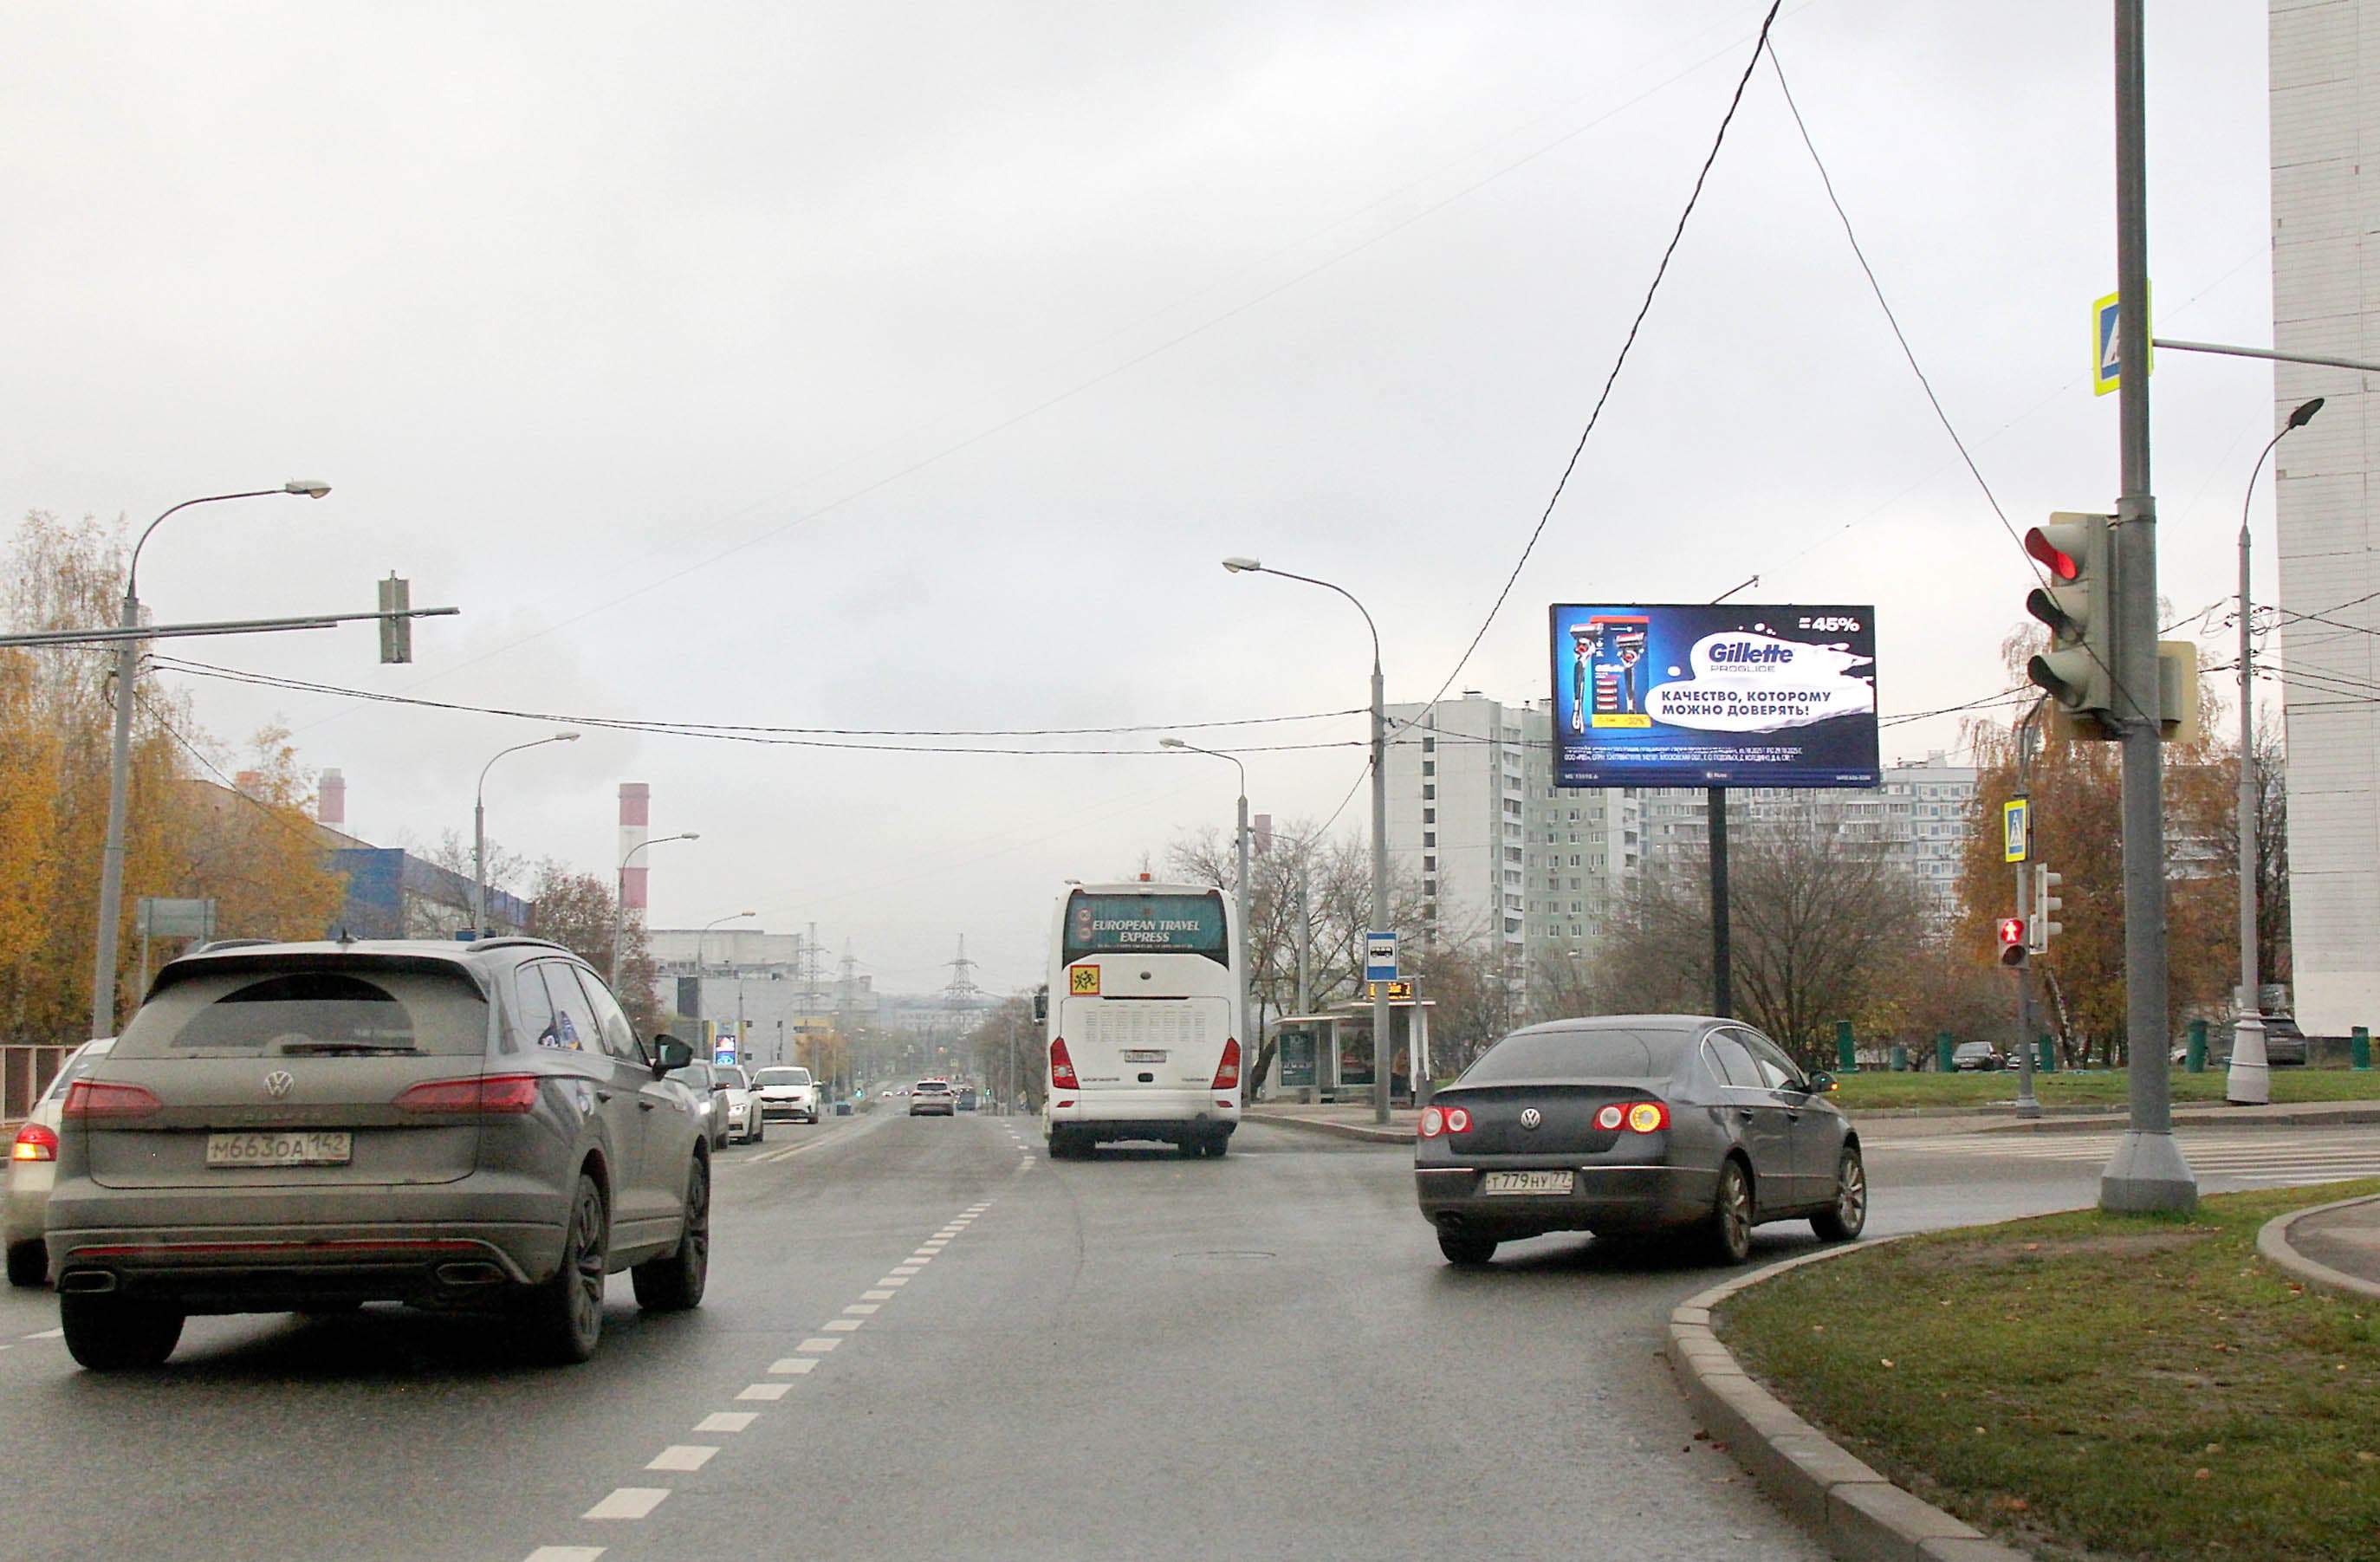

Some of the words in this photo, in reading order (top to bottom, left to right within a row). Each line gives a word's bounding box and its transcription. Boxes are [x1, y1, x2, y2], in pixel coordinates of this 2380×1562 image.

[1709, 642, 1793, 663] Gillette
[1662, 690, 1742, 703] КАЧЕСТВО,
[1747, 691, 1831, 702] КОТОРОМУ
[1662, 704, 1723, 716] МОЖНО
[1727, 704, 1810, 717] ДОВЕРЯТЬ!
[1093, 920, 1156, 931] EUROPEAN
[1158, 920, 1200, 931] TRAVEL
[1119, 931, 1171, 943] EXPRESS
